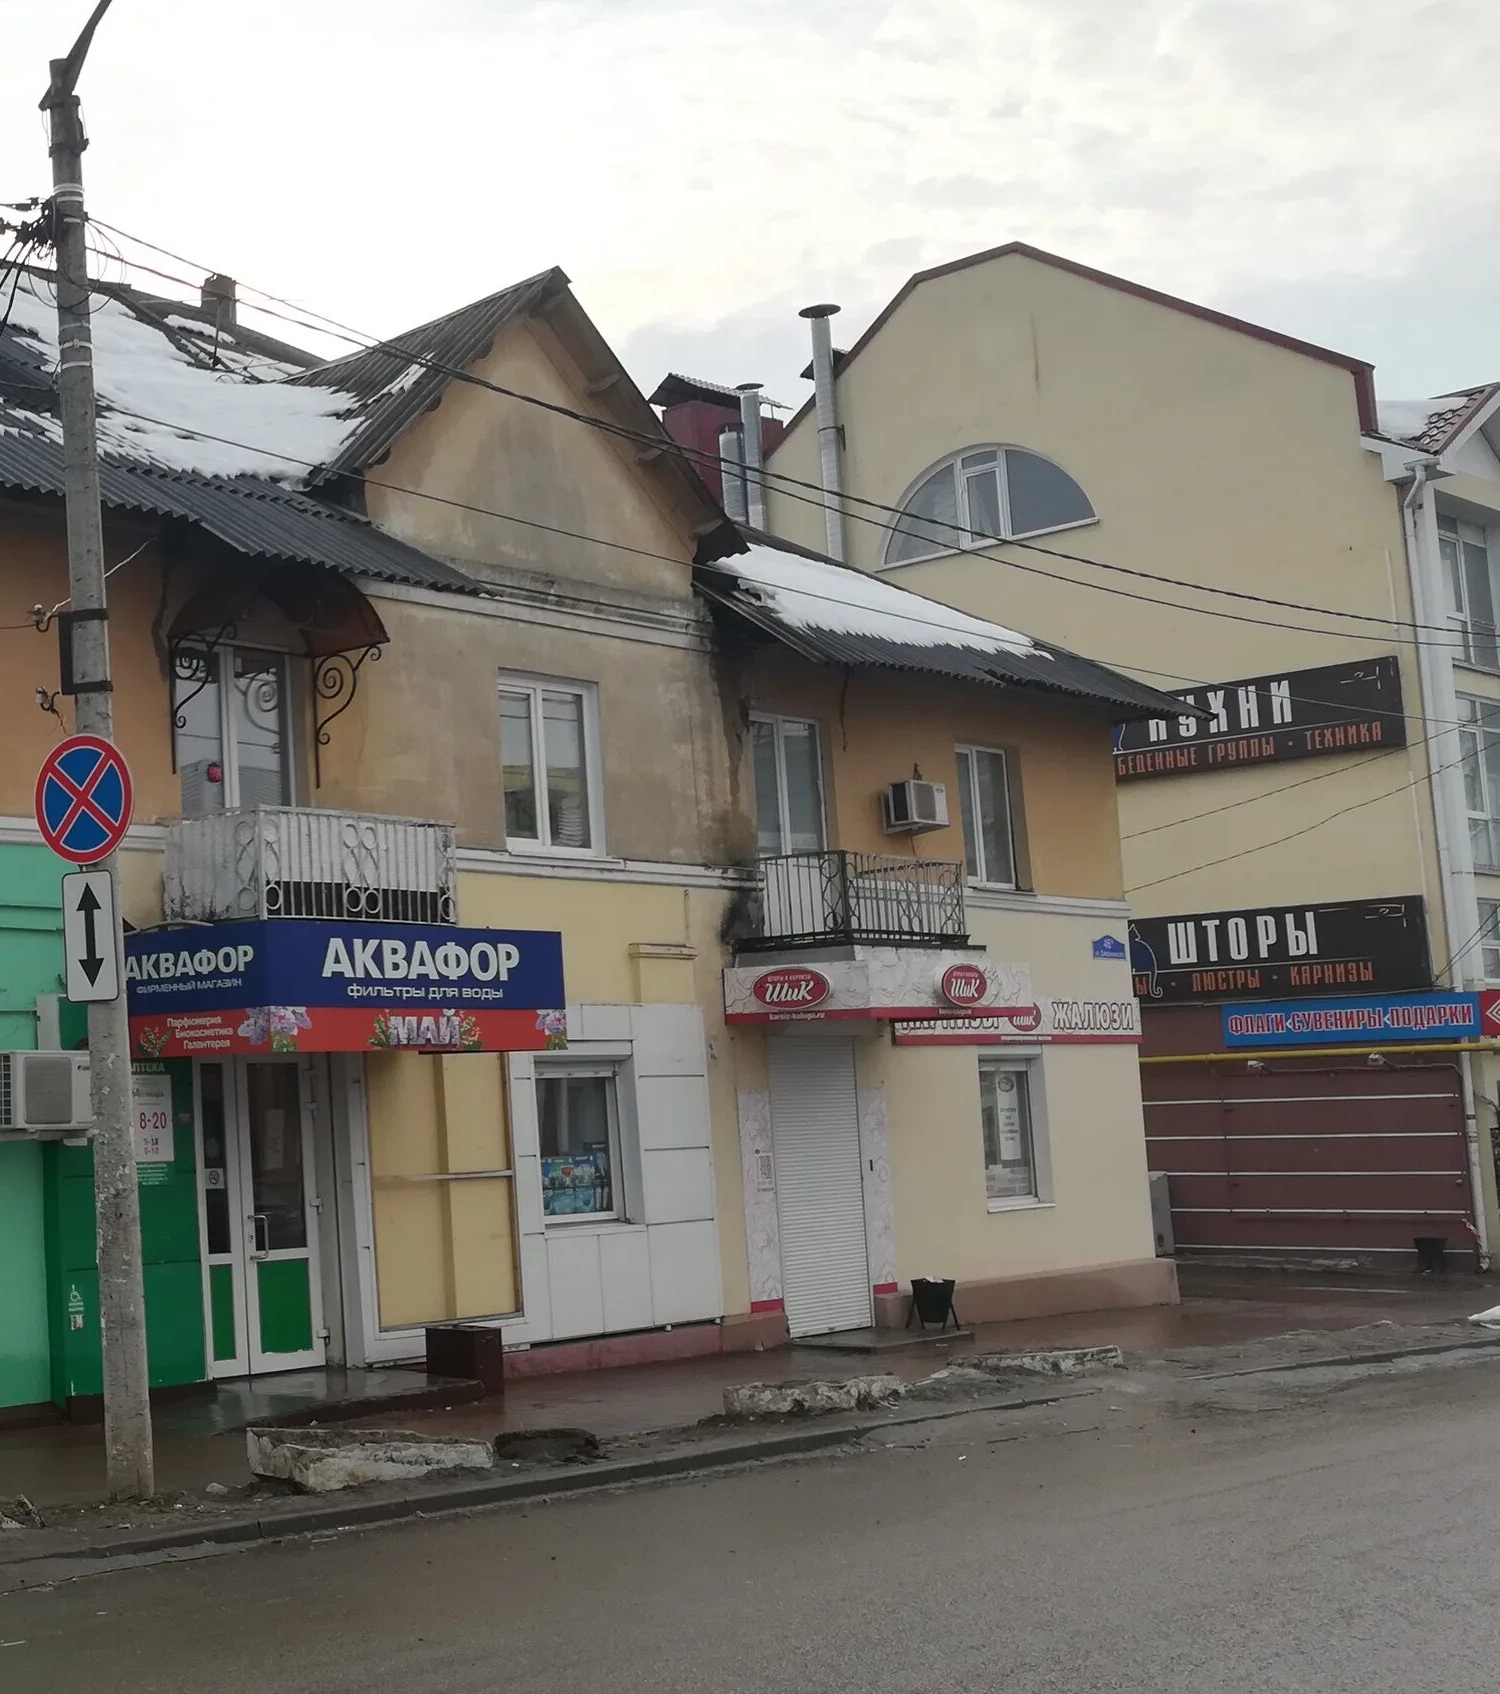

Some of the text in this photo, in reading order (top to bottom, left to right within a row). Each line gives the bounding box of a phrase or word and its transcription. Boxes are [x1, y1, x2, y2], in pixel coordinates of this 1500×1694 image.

[1117, 721, 1383, 776] БЕДЕННЫЕ ГРУППЫ ТЕХНИКА
[1167, 911, 1318, 965] ШТОРЫ
[125, 945, 254, 981] АКВАФОР
[322, 937, 520, 982] АКВАФОР
[136, 978, 243, 994] ФИРМЕННЫЙ МАГАЗИН
[1192, 961, 1373, 993] ЛЮСТРЫ КАРНИЗЫ
[389, 1008, 461, 1046] МАЙ
[1052, 1001, 1135, 1031] ЖАЛЮЗИ
[1228, 1004, 1474, 1035] ФЛАГИ СУВЕНИРЫ ПОДАРКИ
[131, 1062, 165, 1072] ПТЕКА
